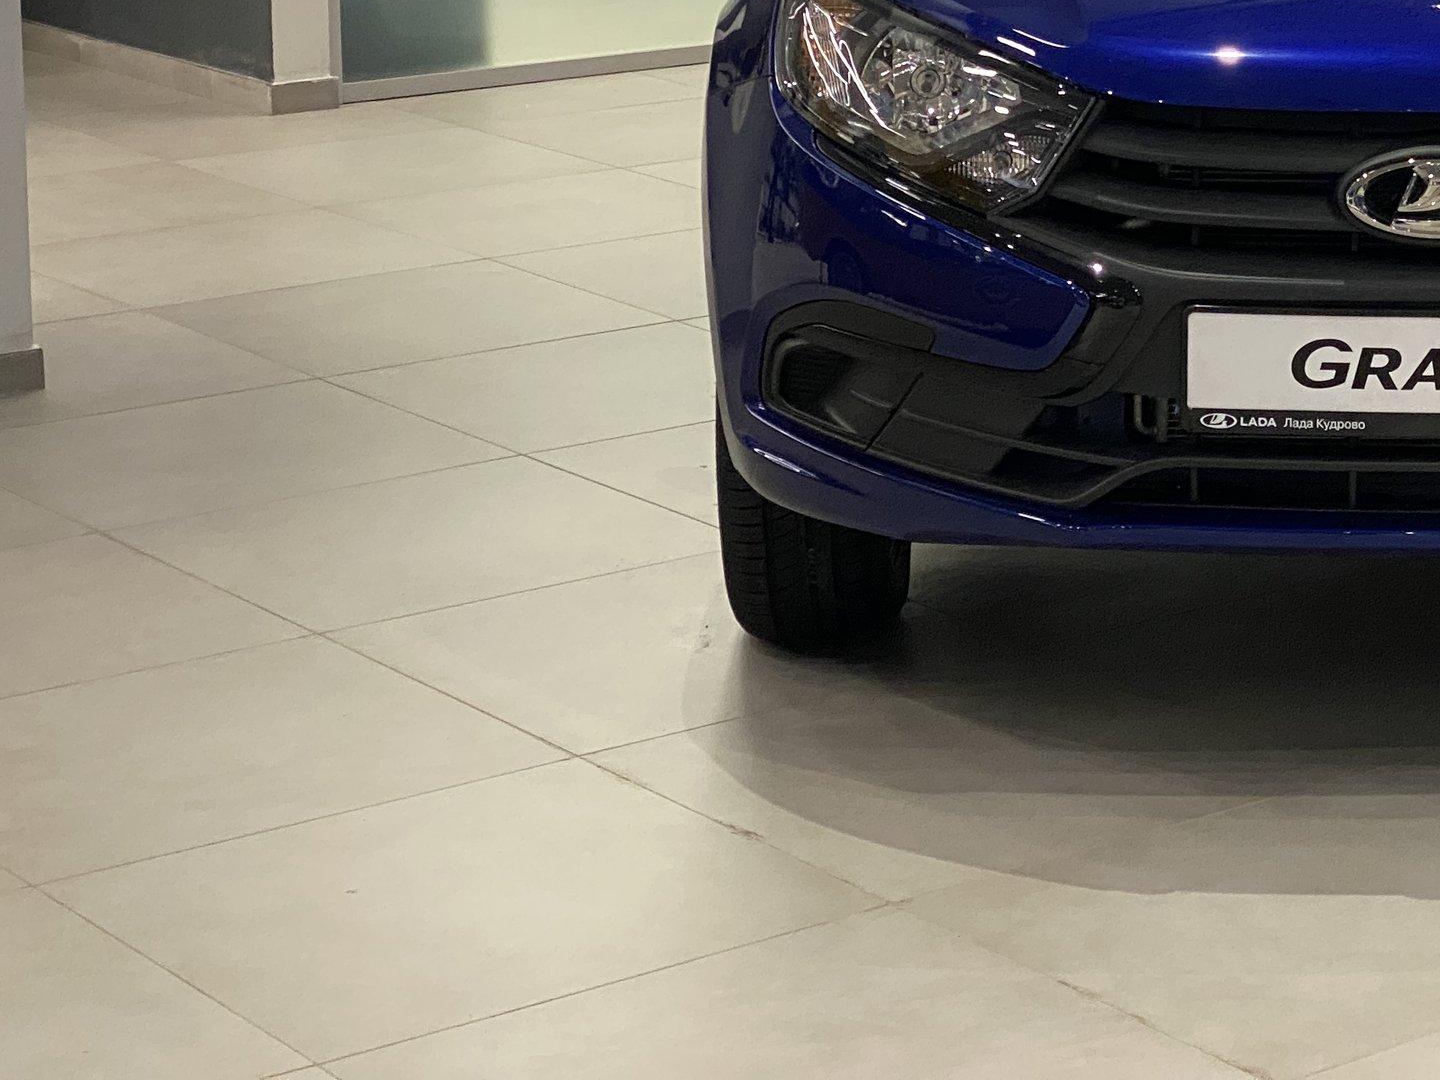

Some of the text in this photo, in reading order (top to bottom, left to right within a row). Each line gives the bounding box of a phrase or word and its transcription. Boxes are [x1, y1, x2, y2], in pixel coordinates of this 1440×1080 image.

[1240, 417, 1366, 431] LADA Лада Кудрово
